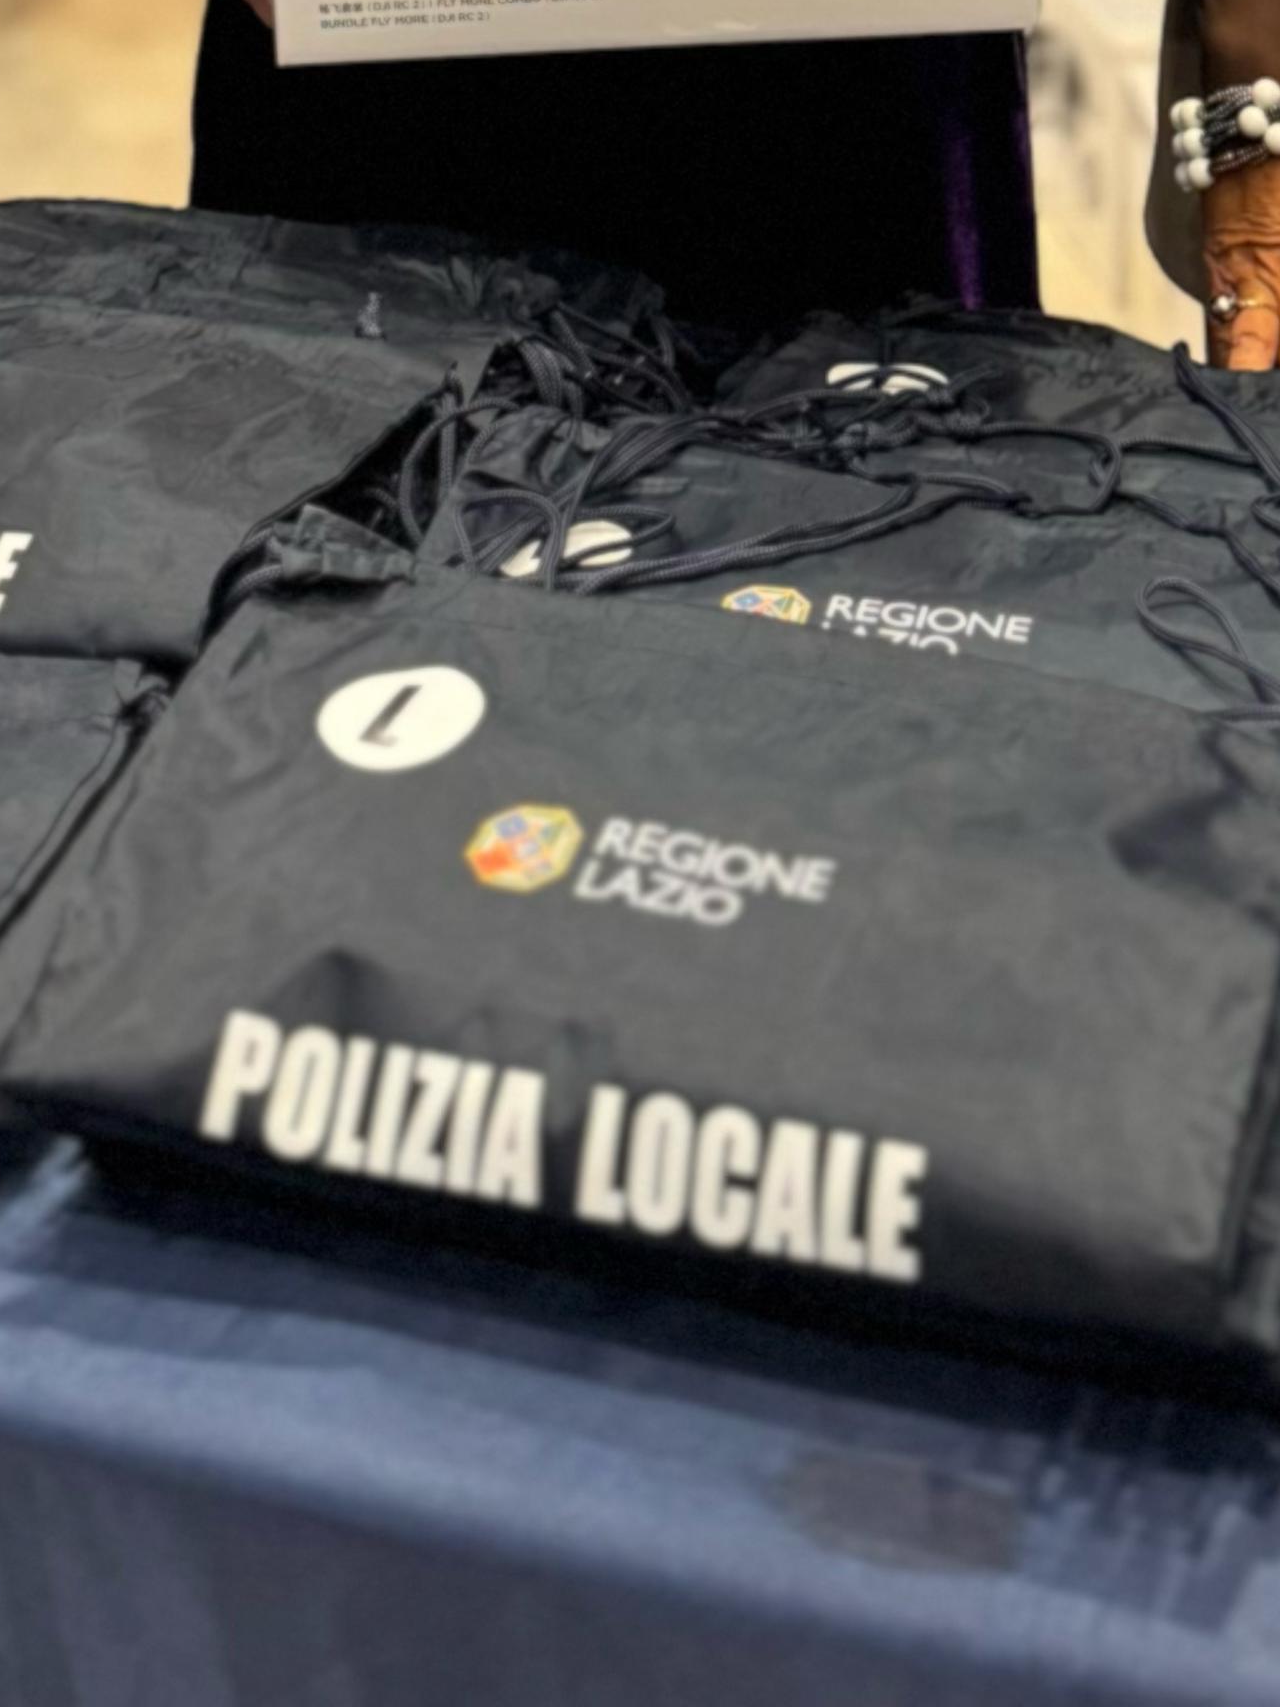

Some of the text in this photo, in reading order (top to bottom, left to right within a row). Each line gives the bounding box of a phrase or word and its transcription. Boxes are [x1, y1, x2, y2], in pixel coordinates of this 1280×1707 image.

[320, 17, 368, 29] BUNDLE
[370, 16, 391, 27] FLY
[394, 14, 429, 25] MORE
[825, 593, 1034, 644] REGIONE
[359, 684, 423, 749] L
[573, 857, 743, 926] LAZIO
[593, 815, 837, 904] REGIONE
[200, 1008, 928, 1283] POLIZIA LOCALE
